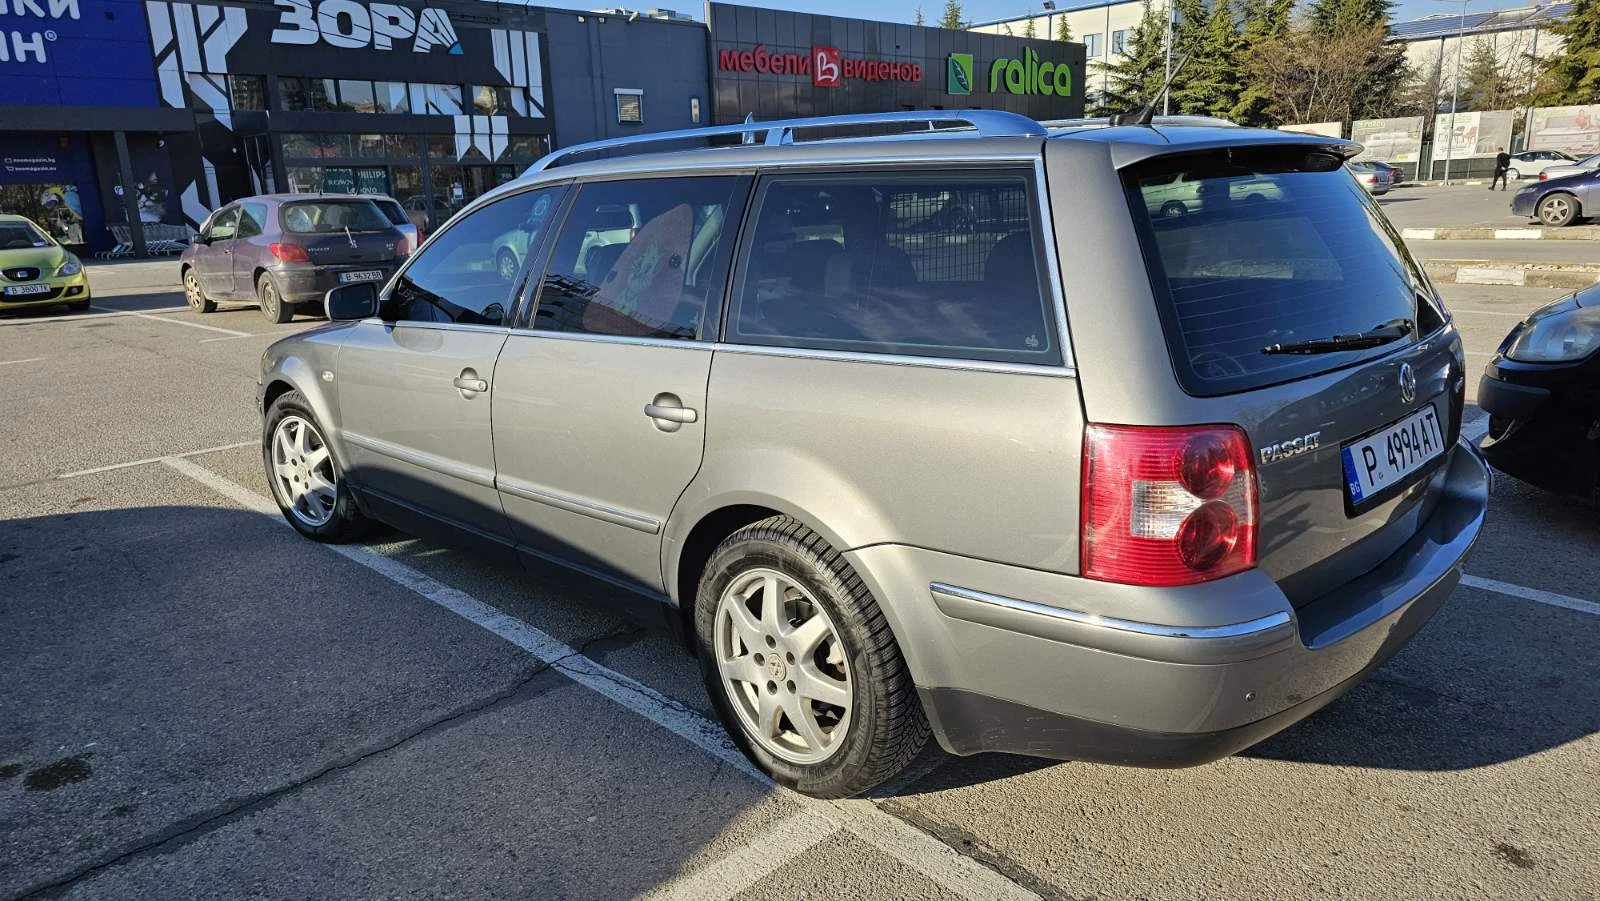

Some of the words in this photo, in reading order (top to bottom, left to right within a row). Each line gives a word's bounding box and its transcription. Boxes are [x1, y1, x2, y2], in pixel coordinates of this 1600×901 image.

[271, 0, 464, 54] ЗОРА
[720, 44, 810, 75] мебели
[843, 59, 921, 81] виденов
[989, 46, 1071, 96] ralica
[1260, 431, 1321, 464] PASSAT
